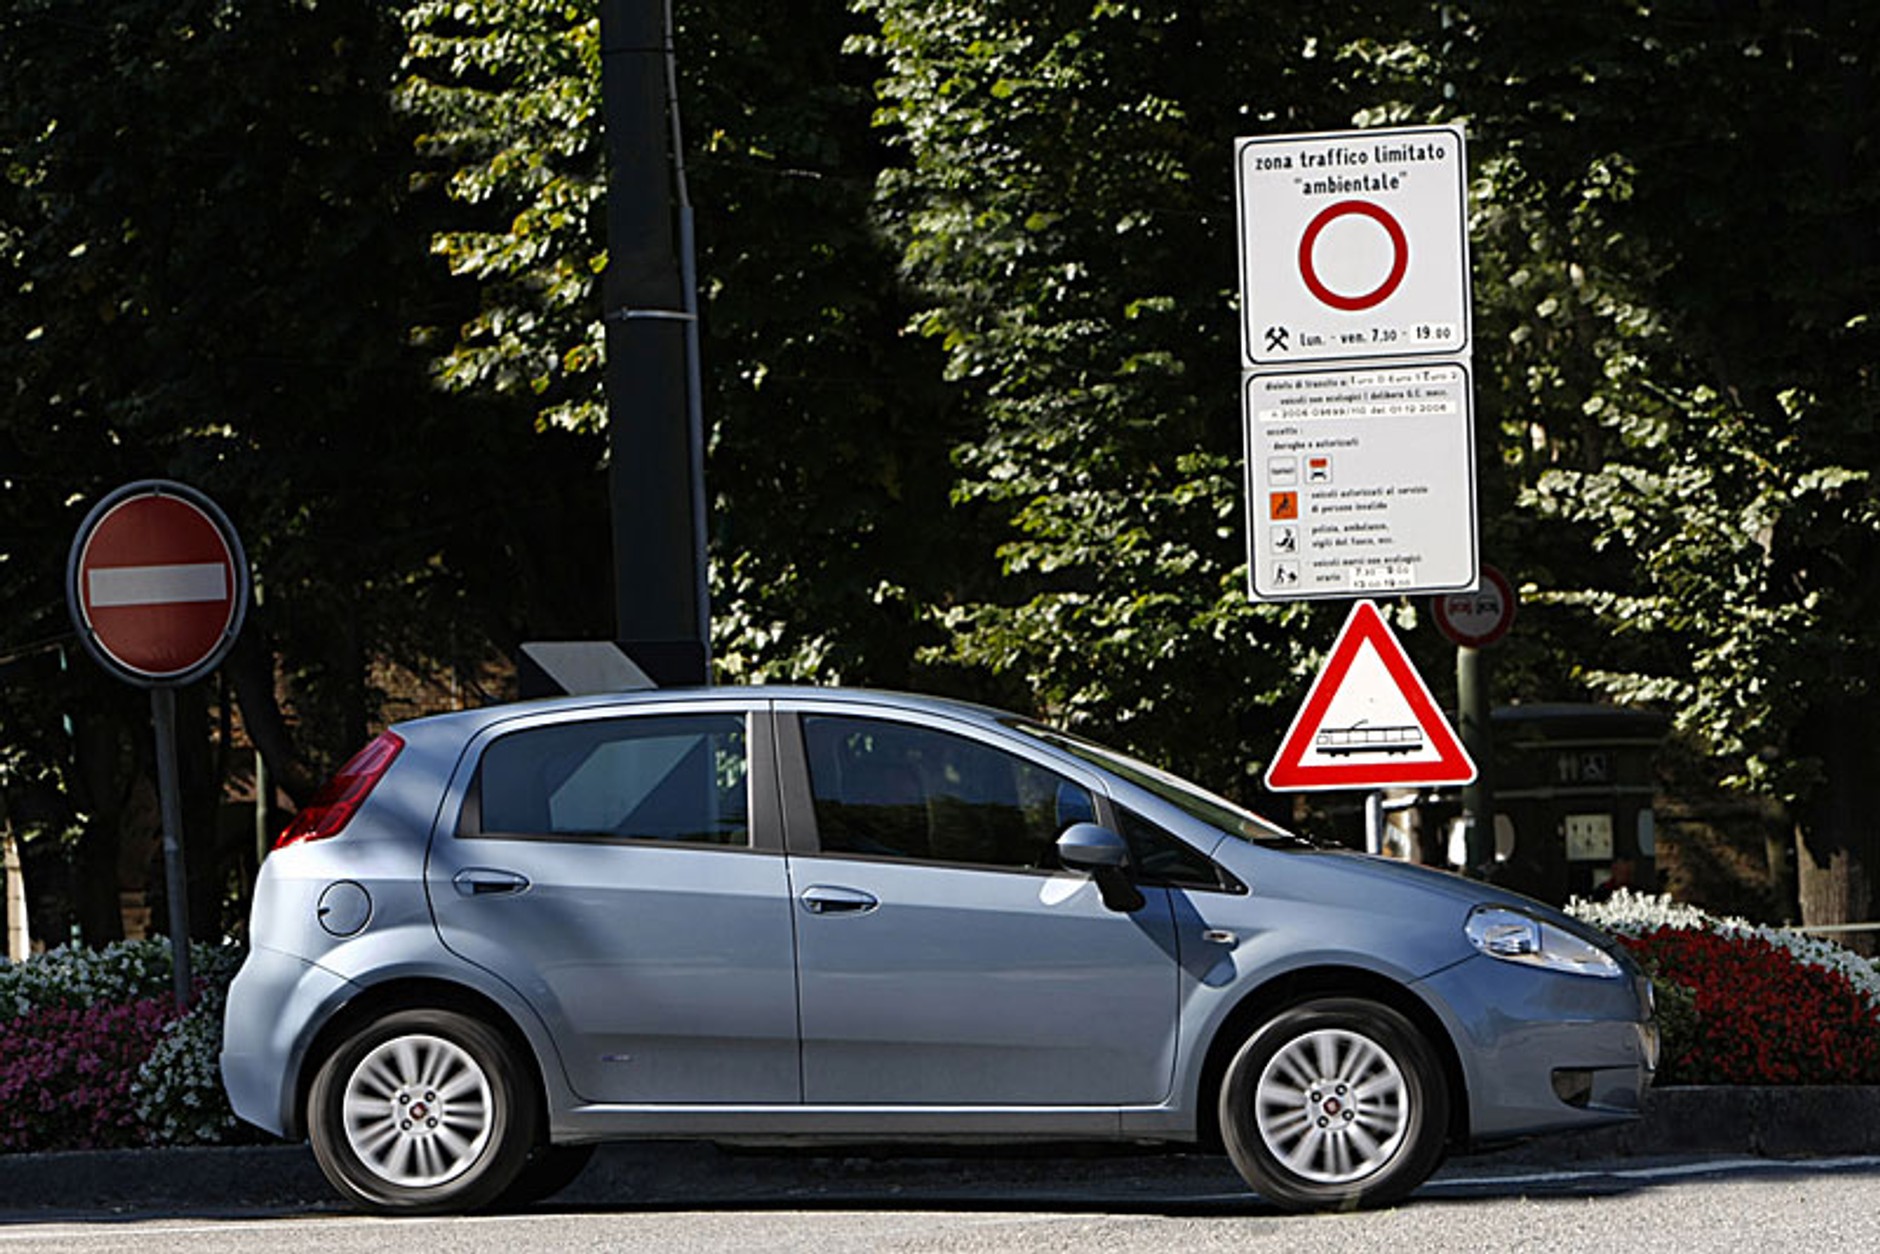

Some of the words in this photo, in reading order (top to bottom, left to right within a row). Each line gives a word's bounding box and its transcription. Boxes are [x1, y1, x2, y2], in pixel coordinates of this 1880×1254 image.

[1255, 154, 1293, 170] zona
[1300, 147, 1368, 167] traffico
[1374, 143, 1445, 163] limitato
[1294, 171, 1408, 195] "ambientale"
